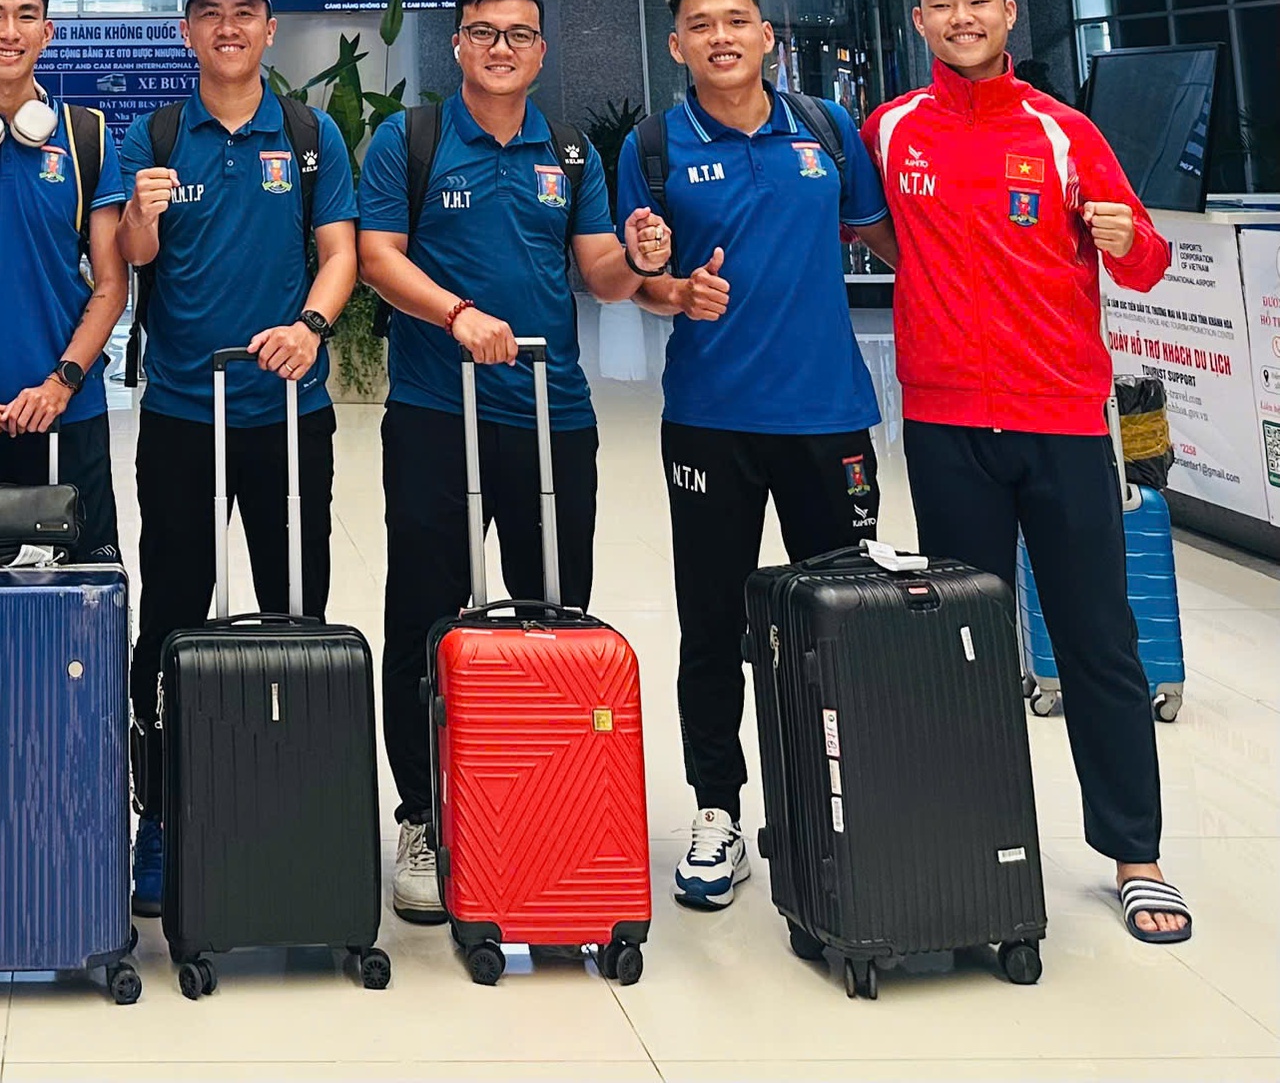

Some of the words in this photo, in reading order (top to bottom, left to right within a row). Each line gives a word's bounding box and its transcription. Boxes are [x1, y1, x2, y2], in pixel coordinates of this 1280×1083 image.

[71, 24, 101, 40] HÀNG
[105, 22, 142, 40] KHÔNG
[147, 21, 176, 40] QUỐC
[105, 48, 115, 58] XE
[138, 77, 157, 89] XE
[161, 74, 198, 89] BUÝT
[687, 162, 725, 183] N.T.N
[899, 172, 936, 196] N.T.N
[442, 191, 471, 208] V.H.T
[1144, 338, 1160, 363] TRỢ
[1162, 340, 1192, 366] KHÁCH
[1194, 348, 1207, 370] DU
[1208, 351, 1231, 377] LỊCH
[1142, 364, 1166, 379] TOURIST
[1168, 370, 1196, 387] SUPPORT
[673, 462, 706, 493] N.T.N
[852, 518, 876, 527] KAMITO
